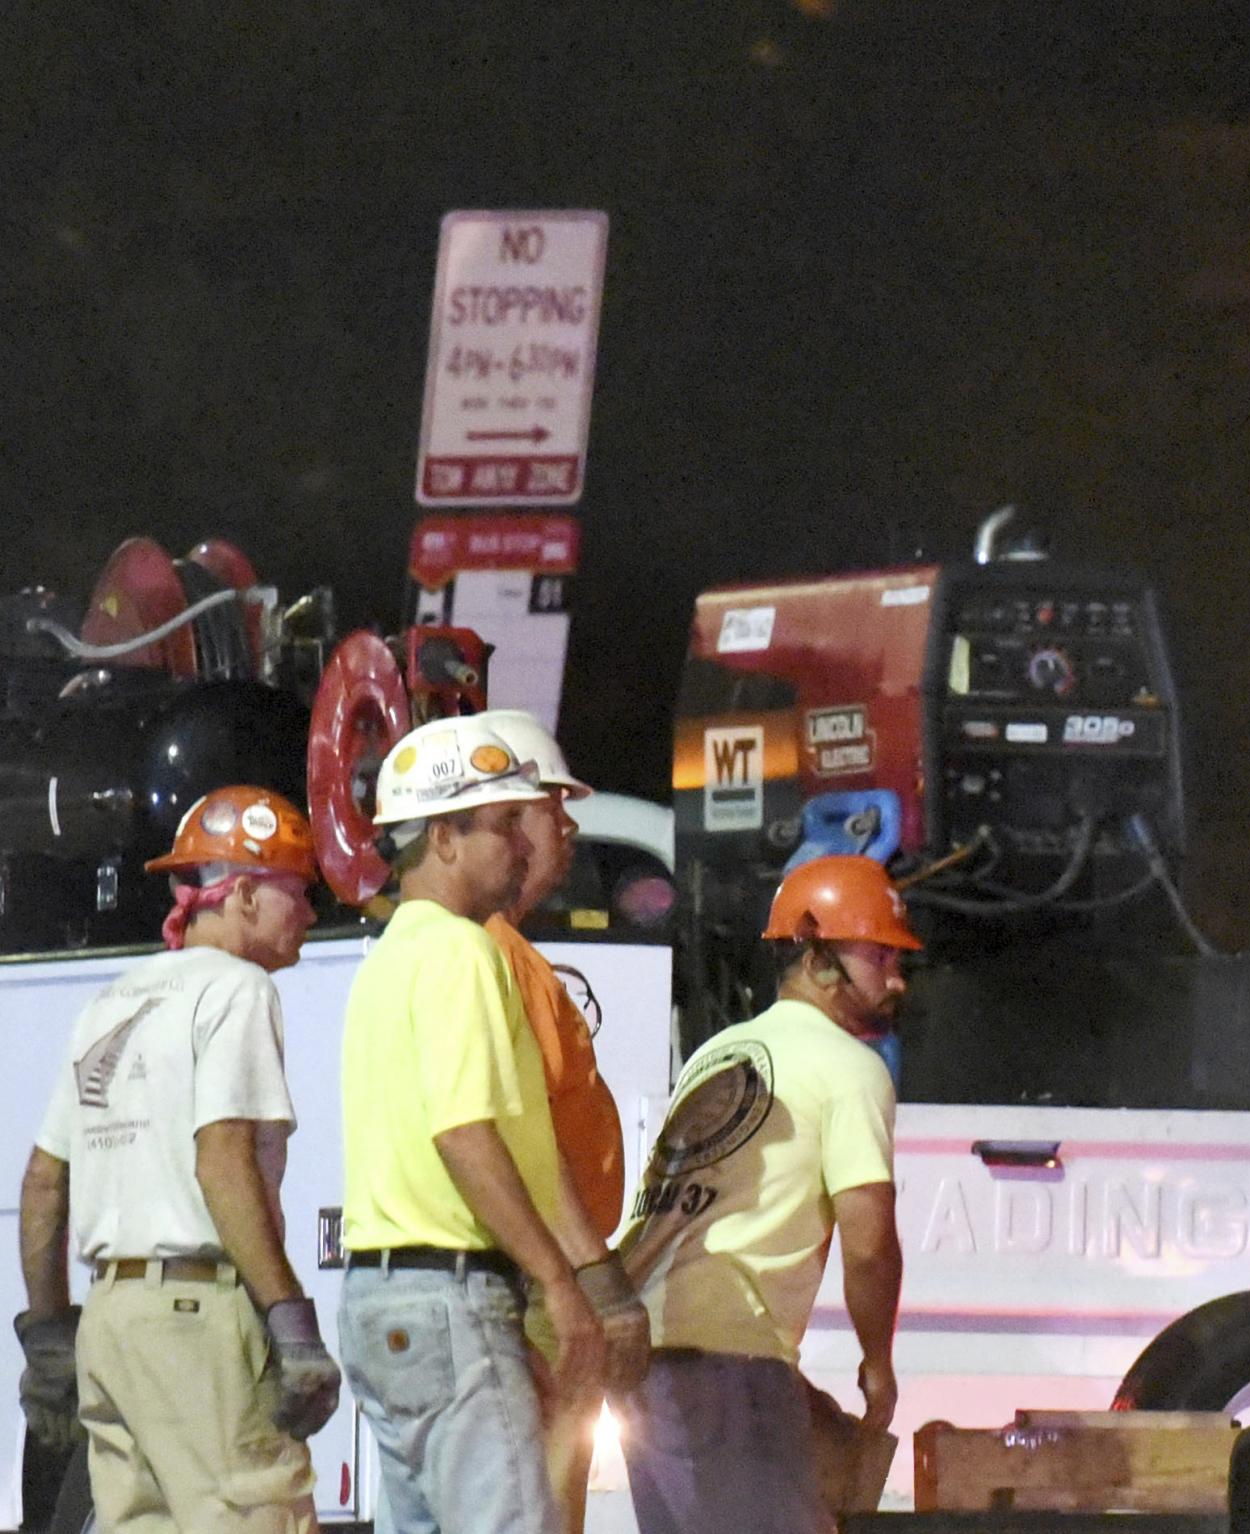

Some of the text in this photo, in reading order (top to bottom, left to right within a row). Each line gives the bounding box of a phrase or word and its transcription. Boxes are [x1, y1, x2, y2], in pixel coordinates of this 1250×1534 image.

[500, 225, 545, 265] NO
[448, 285, 586, 327] STOPPING
[432, 759, 455, 777] 007
[711, 738, 757, 787] WT
[681, 1183, 718, 1216] 37
[900, 1177, 1250, 1261] ADING
